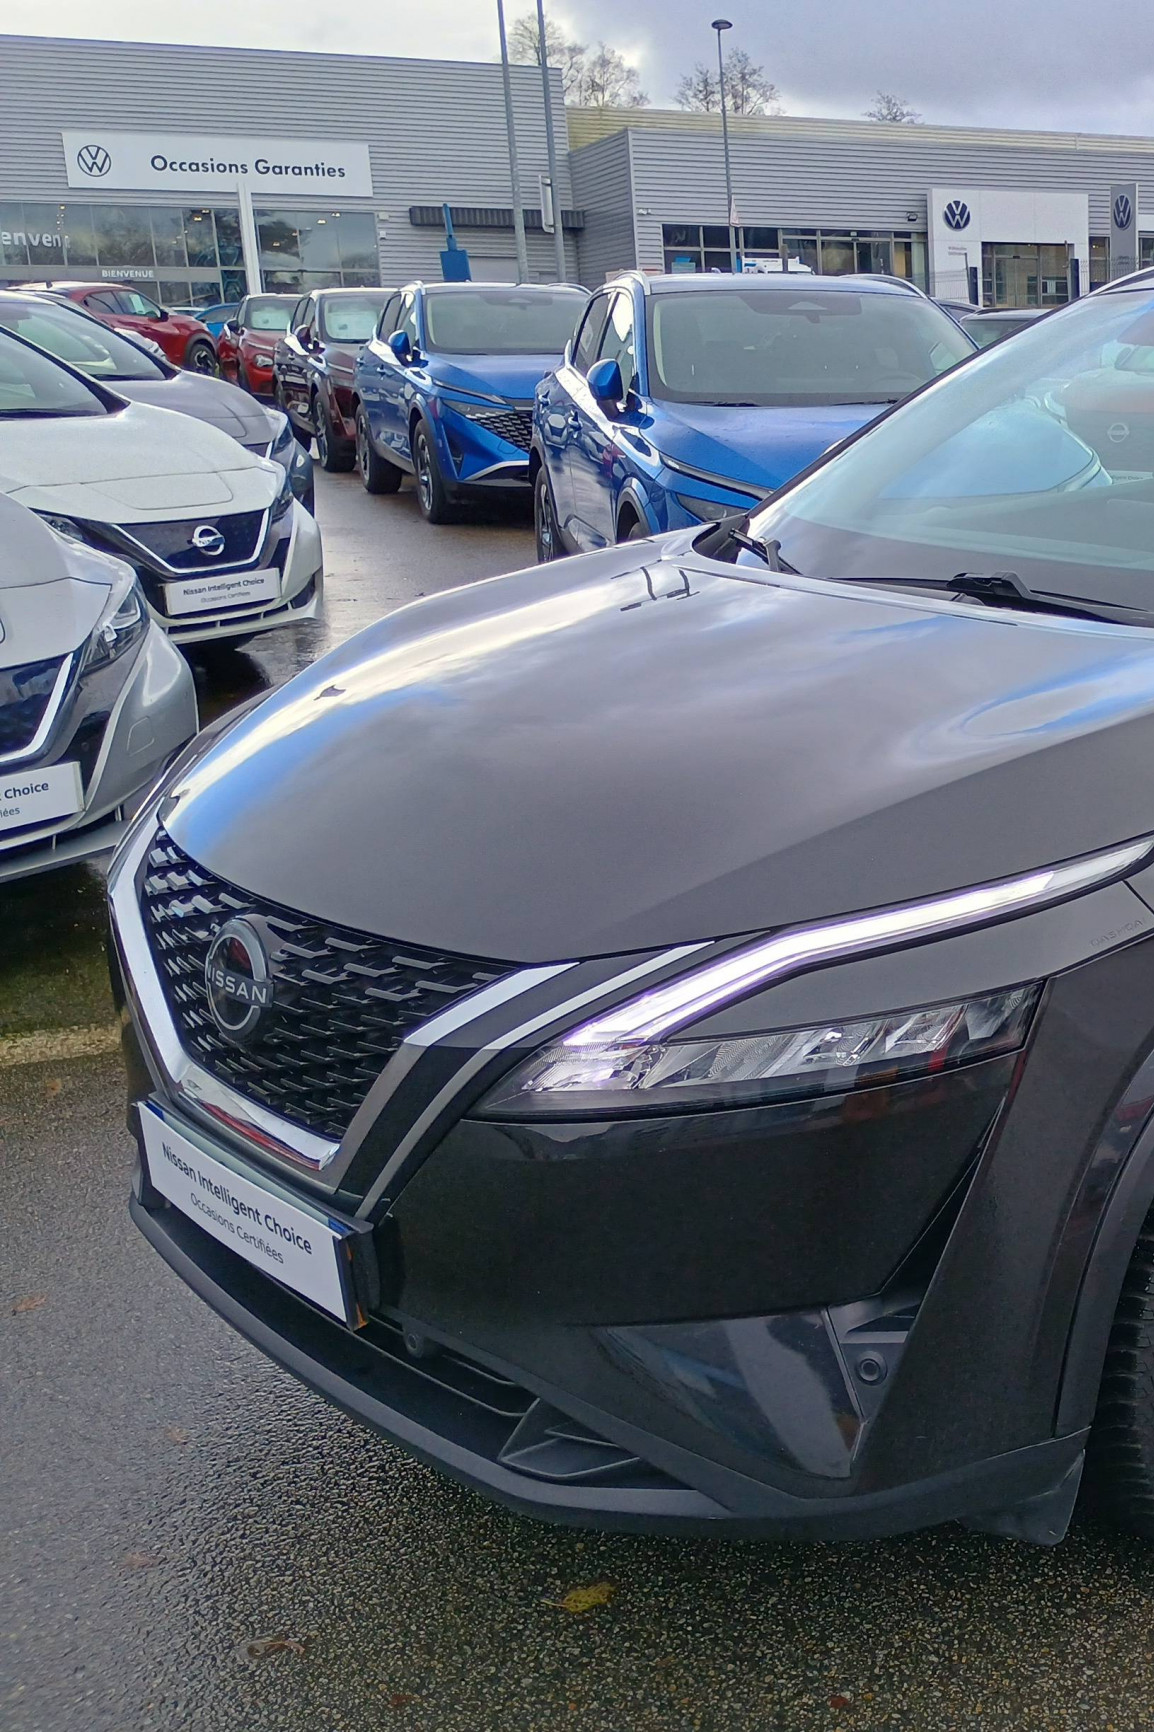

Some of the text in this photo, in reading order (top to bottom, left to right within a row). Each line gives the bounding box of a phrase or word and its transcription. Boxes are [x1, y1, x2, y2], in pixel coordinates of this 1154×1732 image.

[150, 154, 346, 178] Occasions Garanties
[101, 269, 154, 278] BIENVENUE
[183, 578, 265, 596] Nissan Intelligent Choice
[4, 782, 49, 799] Choice
[162, 1141, 312, 1255] Nissan Intelligent Choice
[190, 1192, 284, 1264] Occasions Certifiées
